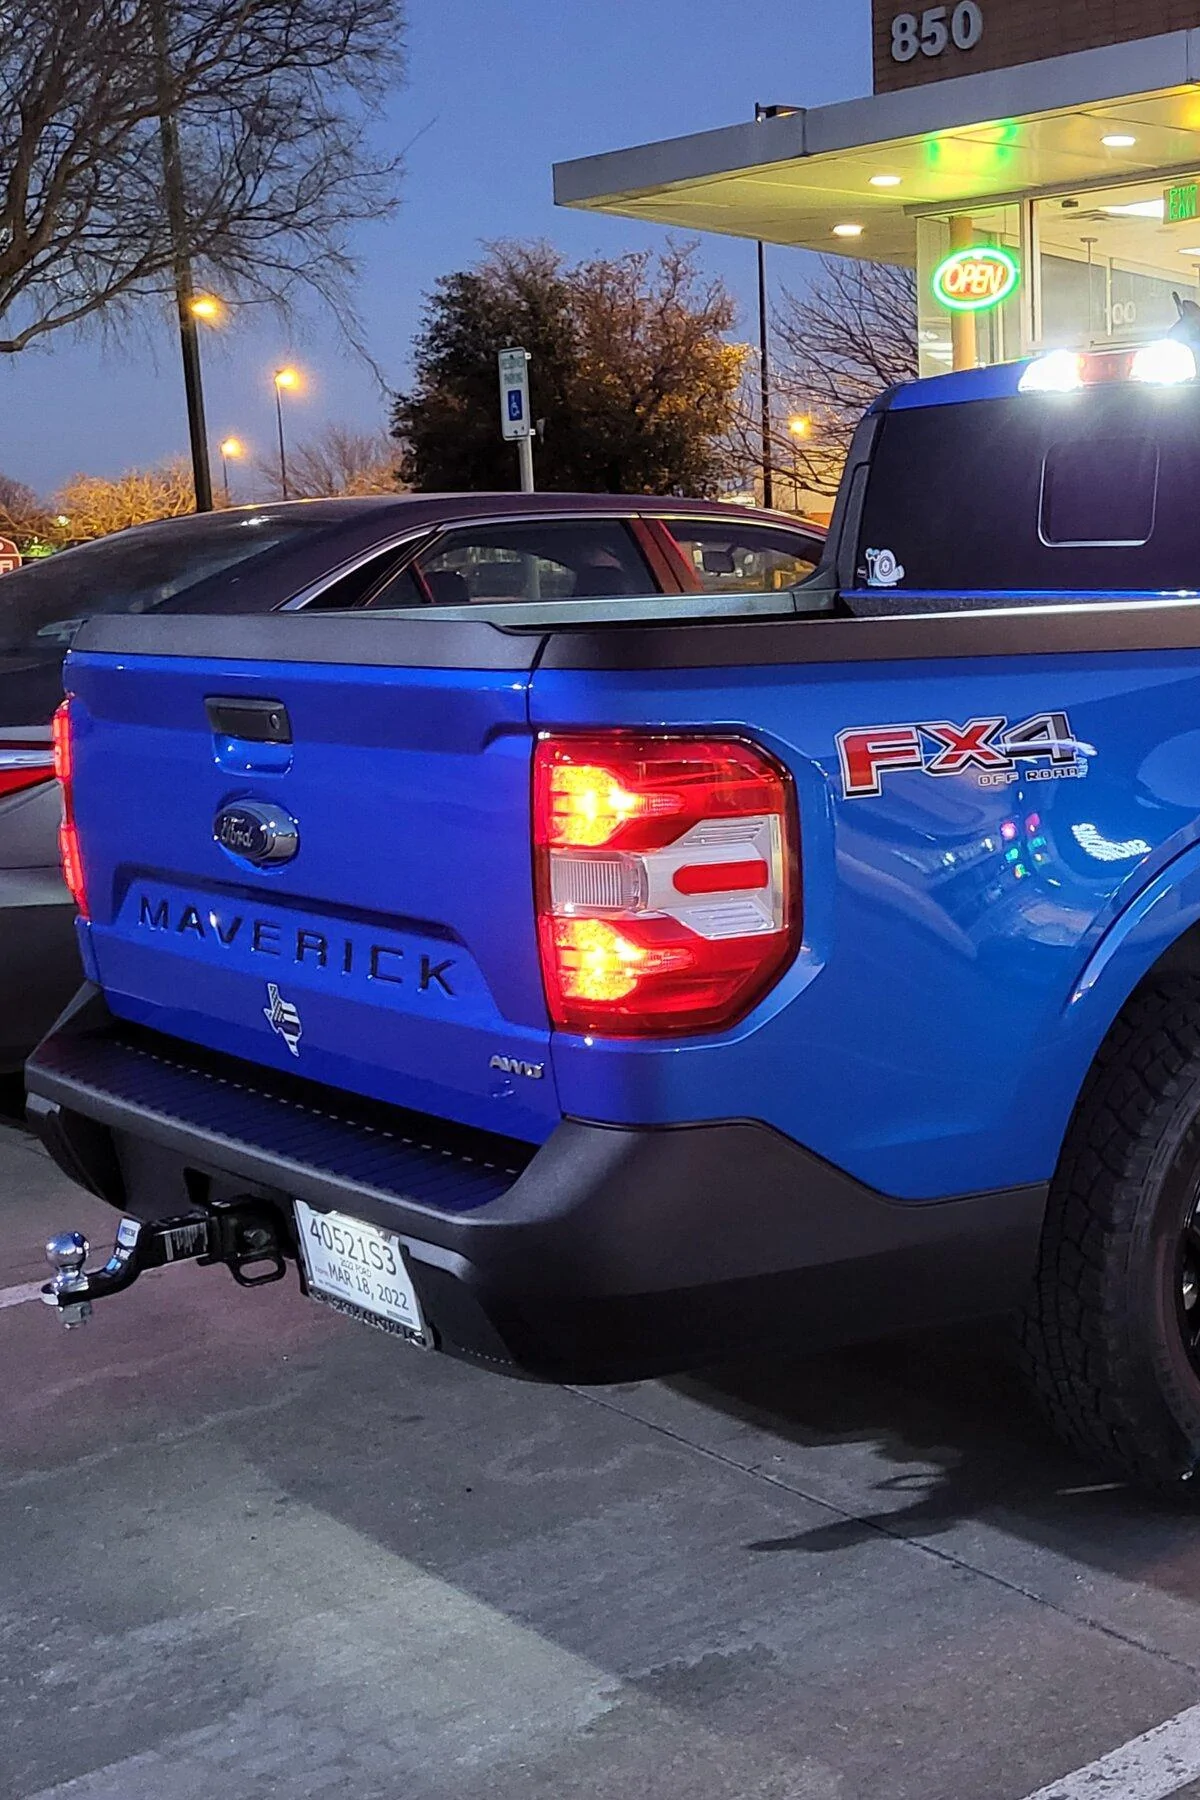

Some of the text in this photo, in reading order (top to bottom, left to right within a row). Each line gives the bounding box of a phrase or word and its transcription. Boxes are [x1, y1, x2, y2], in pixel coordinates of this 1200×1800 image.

[891, 0, 983, 62] 850
[944, 263, 1007, 294] OPEN
[1105, 301, 1137, 325] 00
[835, 711, 1077, 800] FX4
[979, 765, 1080, 786] OFF ROAD
[221, 816, 253, 848] Ford
[138, 896, 457, 998] MAVERICK
[490, 1055, 542, 1079] AWD
[310, 1218, 397, 1276] 40521S3
[328, 1262, 353, 1289] MAR
[356, 1276, 376, 1301] 18,
[377, 1284, 409, 1310] 2022
